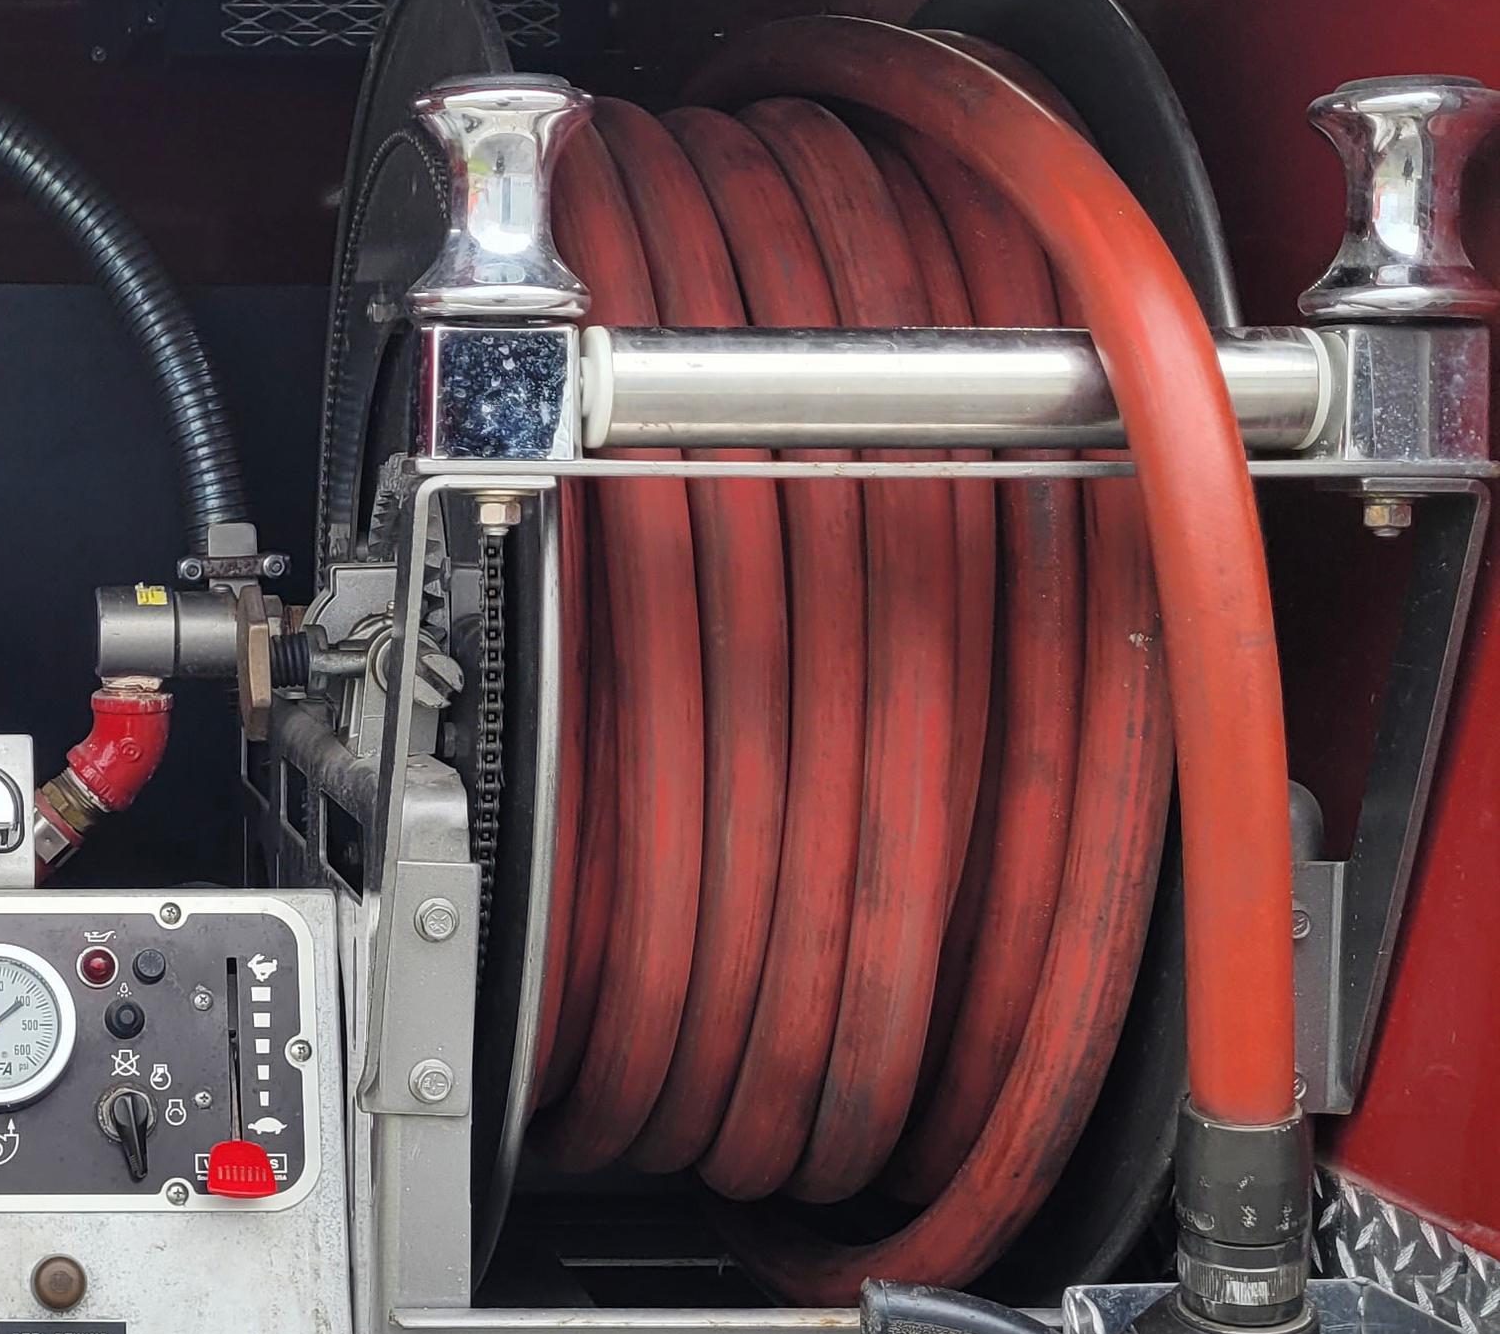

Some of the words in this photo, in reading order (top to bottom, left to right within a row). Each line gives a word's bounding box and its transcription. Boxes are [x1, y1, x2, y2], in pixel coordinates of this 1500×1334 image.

[22, 1020, 39, 1031] 500
[14, 1044, 31, 1056] 600
[19, 1063, 29, 1072] psi
